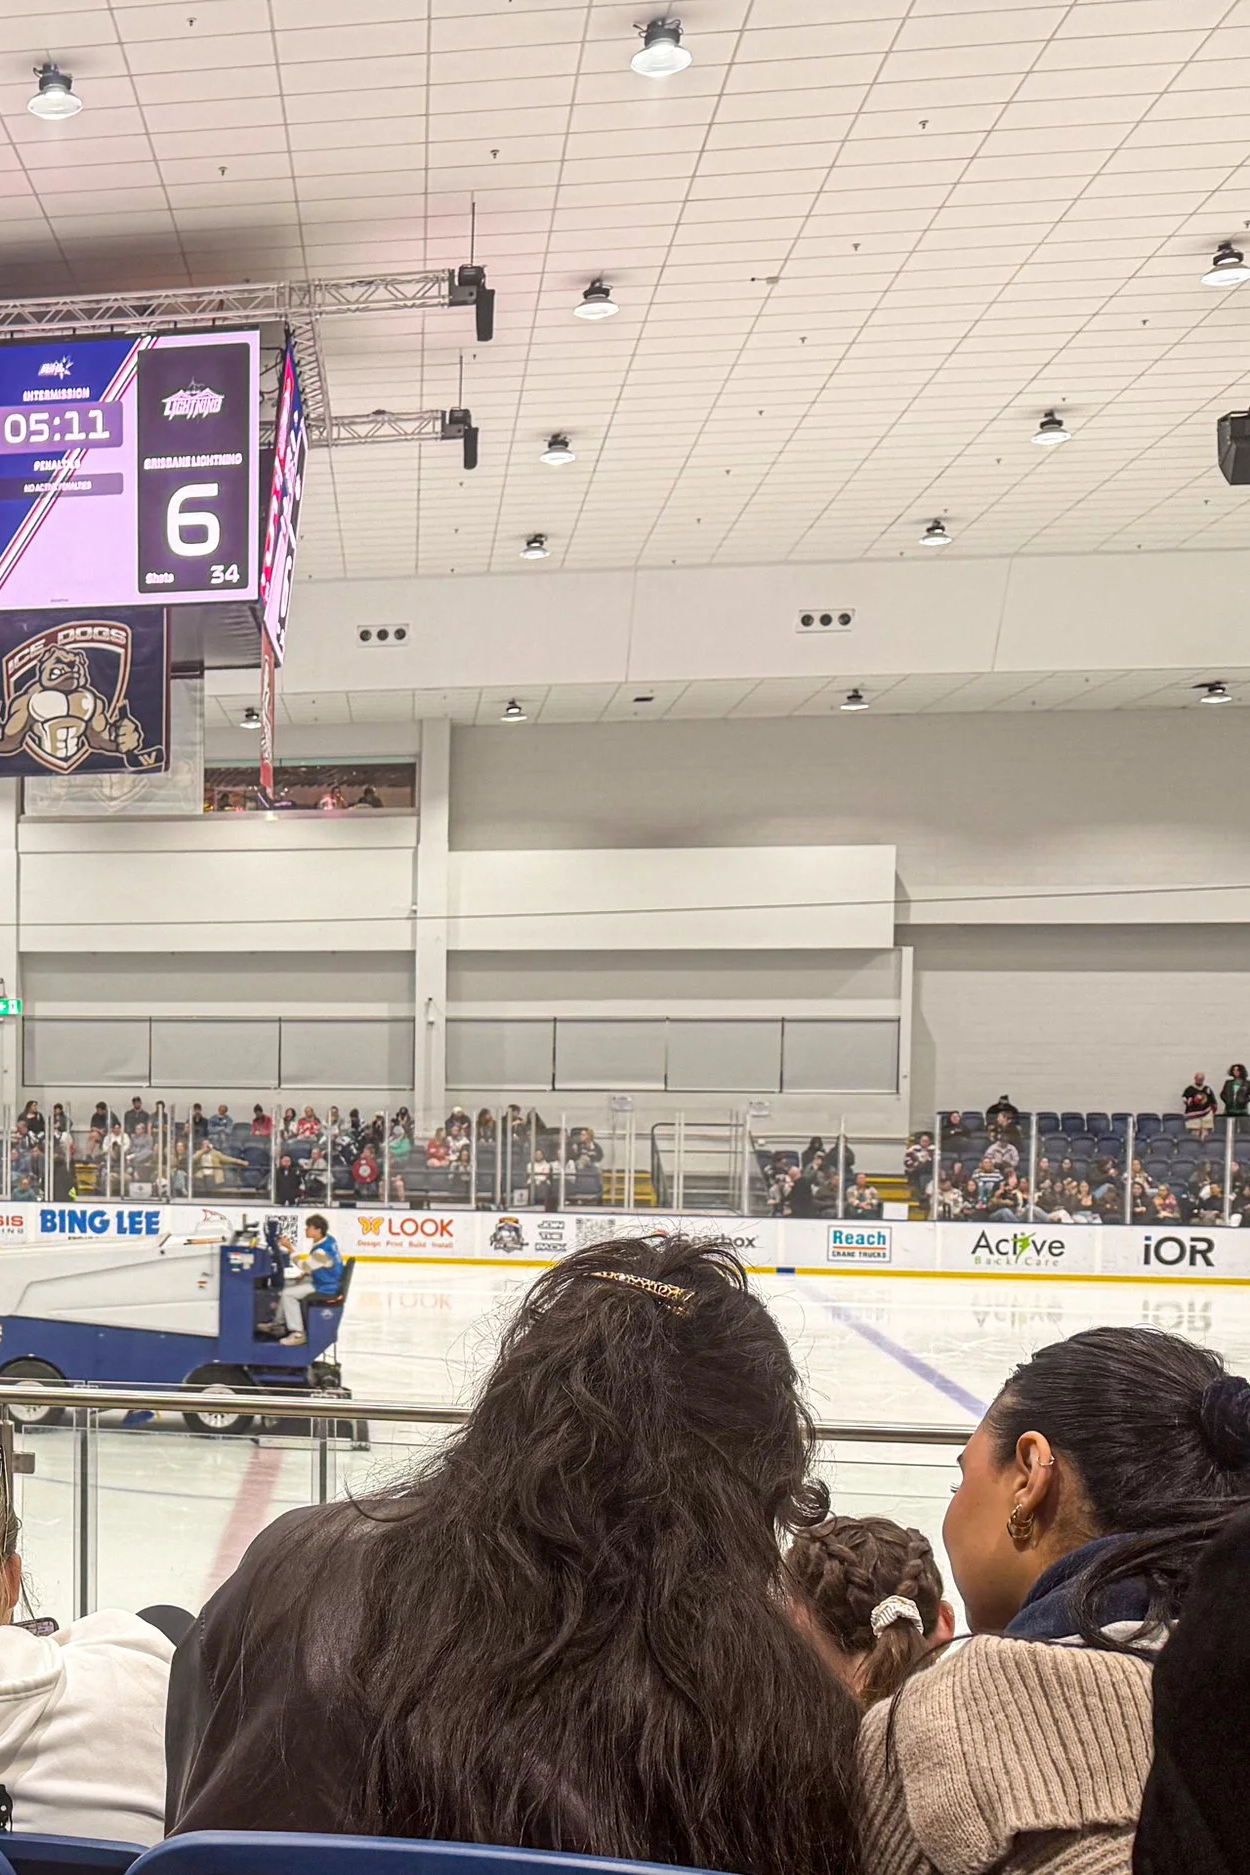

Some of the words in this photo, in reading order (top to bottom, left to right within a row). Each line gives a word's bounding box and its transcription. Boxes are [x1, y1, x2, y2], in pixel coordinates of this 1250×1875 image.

[22, 387, 90, 402] INTERMISSION
[4, 409, 110, 444] 05:11
[33, 458, 81, 472] PENALTIES
[143, 455, 190, 470] BRISBANE
[191, 453, 243, 467] LIGHTNING
[23, 483, 35, 493] NO
[166, 483, 220, 557] 6
[145, 572, 175, 584] Shots
[210, 564, 240, 584] 34
[8, 638, 47, 673] ICE
[56, 626, 127, 645] DOGS
[39, 1208, 110, 1234] BING
[116, 1209, 161, 1235] LEE
[388, 1218, 454, 1238] LOOK
[537, 1220, 565, 1230] JOIN
[539, 1231, 563, 1241] THE
[832, 1229, 887, 1246] Reach
[357, 1240, 381, 1248] Design
[535, 1242, 567, 1251] PACK
[1143, 1235, 1215, 1267] iOR
[858, 1251, 887, 1259] TRUCKS
[974, 1257, 1012, 1265] Back
[1025, 1258, 1060, 1267] Care
